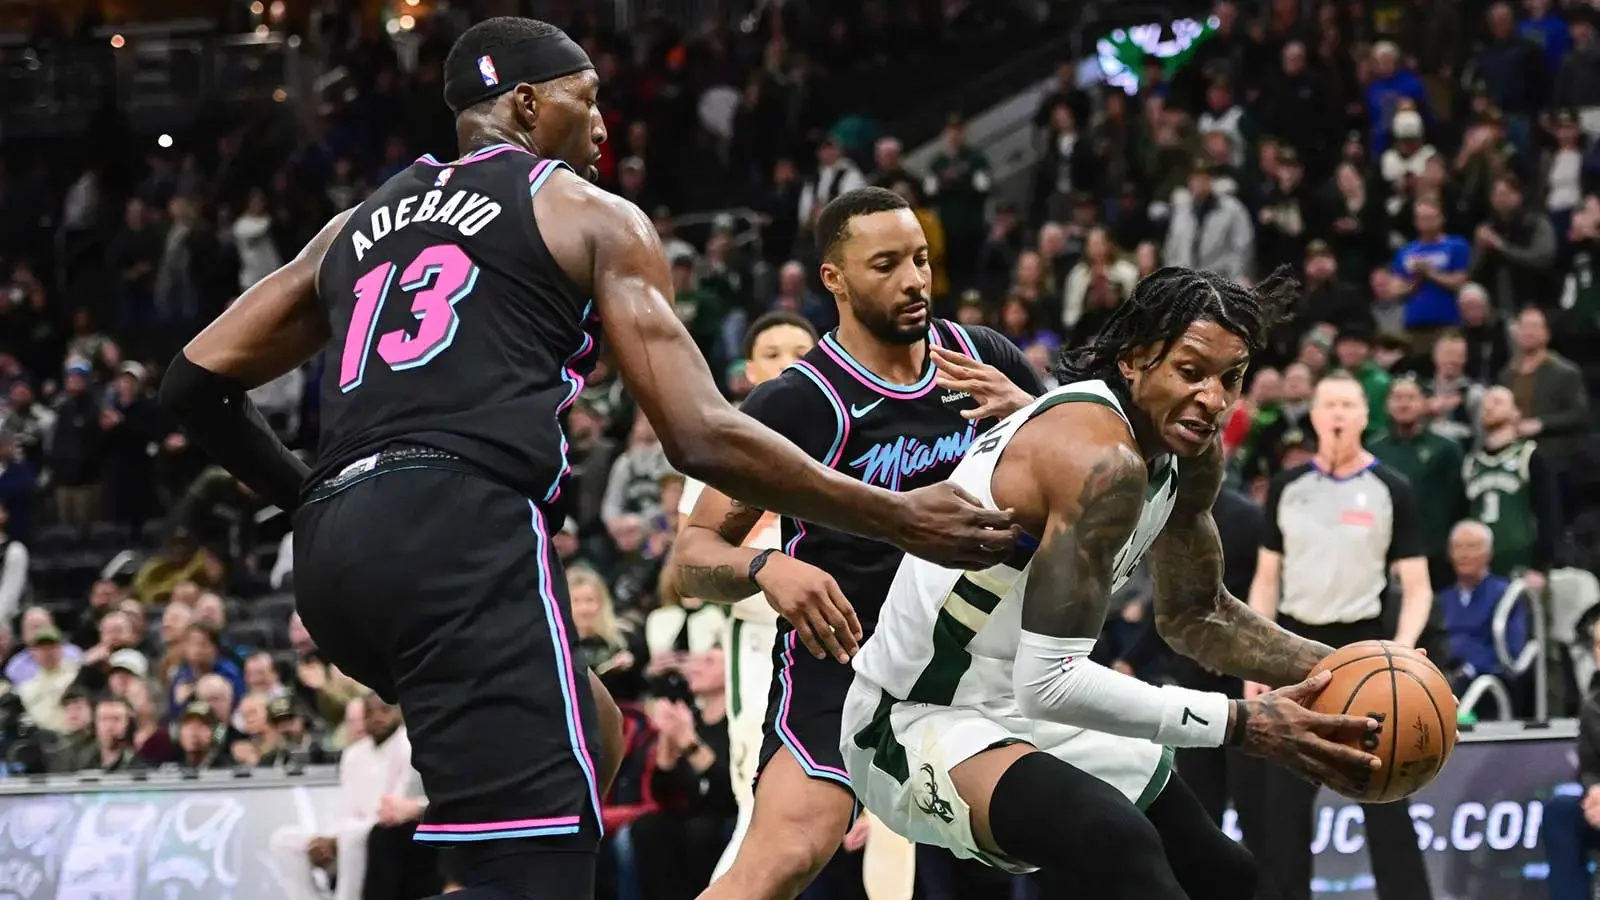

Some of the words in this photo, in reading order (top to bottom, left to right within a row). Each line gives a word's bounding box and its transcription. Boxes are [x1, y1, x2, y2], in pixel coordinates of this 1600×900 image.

[351, 189, 502, 261] ADEBAYO
[339, 244, 480, 393] 13
[849, 418, 979, 491] Miami
[1182, 706, 1209, 727] 7
